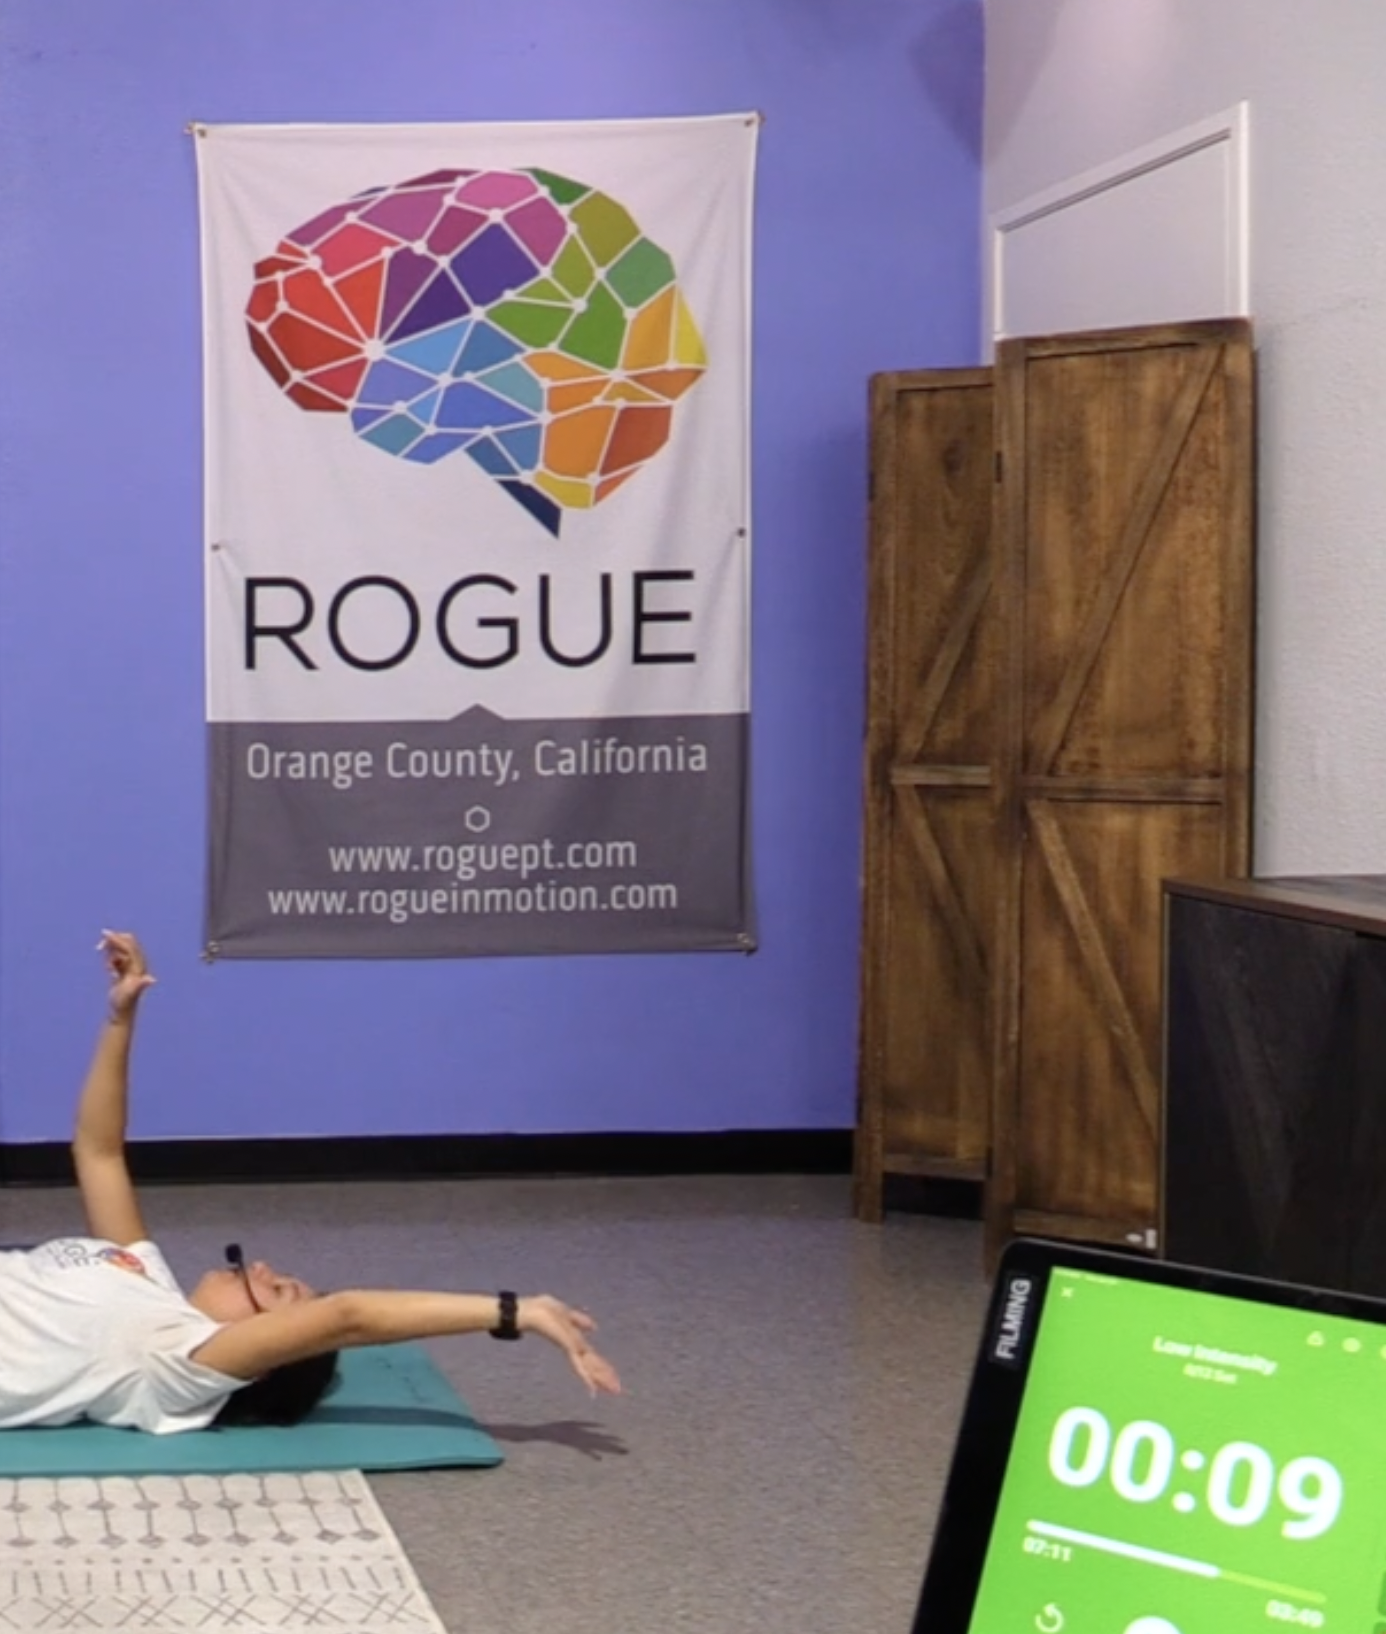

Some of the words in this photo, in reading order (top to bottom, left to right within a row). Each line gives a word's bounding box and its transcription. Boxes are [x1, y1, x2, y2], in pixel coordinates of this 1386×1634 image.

[244, 570, 697, 672] ROGUE
[246, 742, 374, 789] Orange
[386, 741, 521, 786] County,
[534, 736, 709, 778] California
[328, 838, 638, 880] www.roguept.com
[267, 880, 678, 923] www.rogueinmotion.com
[995, 1278, 1032, 1360] FILMING
[1153, 1335, 1194, 1358] Low
[1194, 1344, 1279, 1376] Intensity
[1048, 1406, 1344, 1540] 00:09
[1023, 1536, 1073, 1562] 07:11
